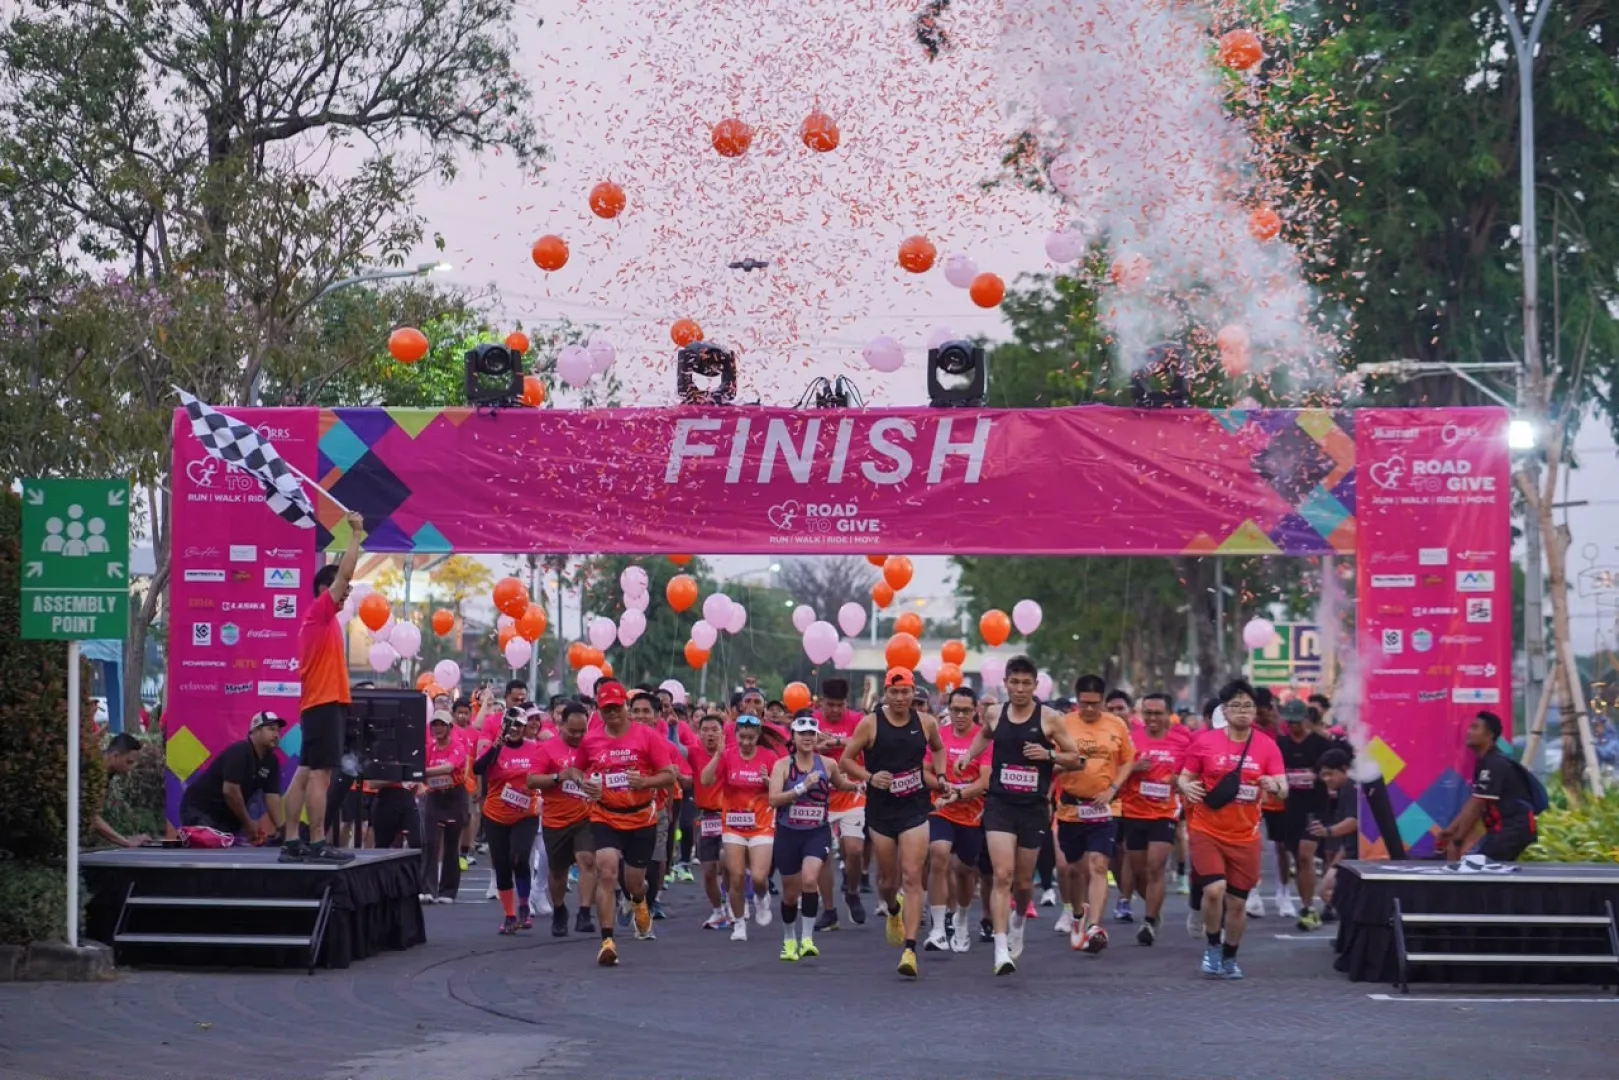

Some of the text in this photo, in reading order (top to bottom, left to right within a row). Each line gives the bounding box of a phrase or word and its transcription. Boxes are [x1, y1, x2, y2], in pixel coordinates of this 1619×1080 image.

[663, 417, 993, 484] FINISH
[1412, 460, 1471, 475] ROAD
[225, 475, 253, 491] TO
[1412, 476, 1496, 492] TO GIVE
[188, 493, 208, 502] RUN
[215, 494, 241, 503] WALK
[806, 503, 858, 517] ROAD
[805, 518, 880, 532] TO GIVE
[769, 535, 789, 544] RUN
[795, 535, 821, 544] WALK
[826, 535, 848, 544] RIDE
[33, 596, 116, 613] ASSEMBLY
[52, 616, 97, 633] POINT
[793, 809, 823, 818] 10122
